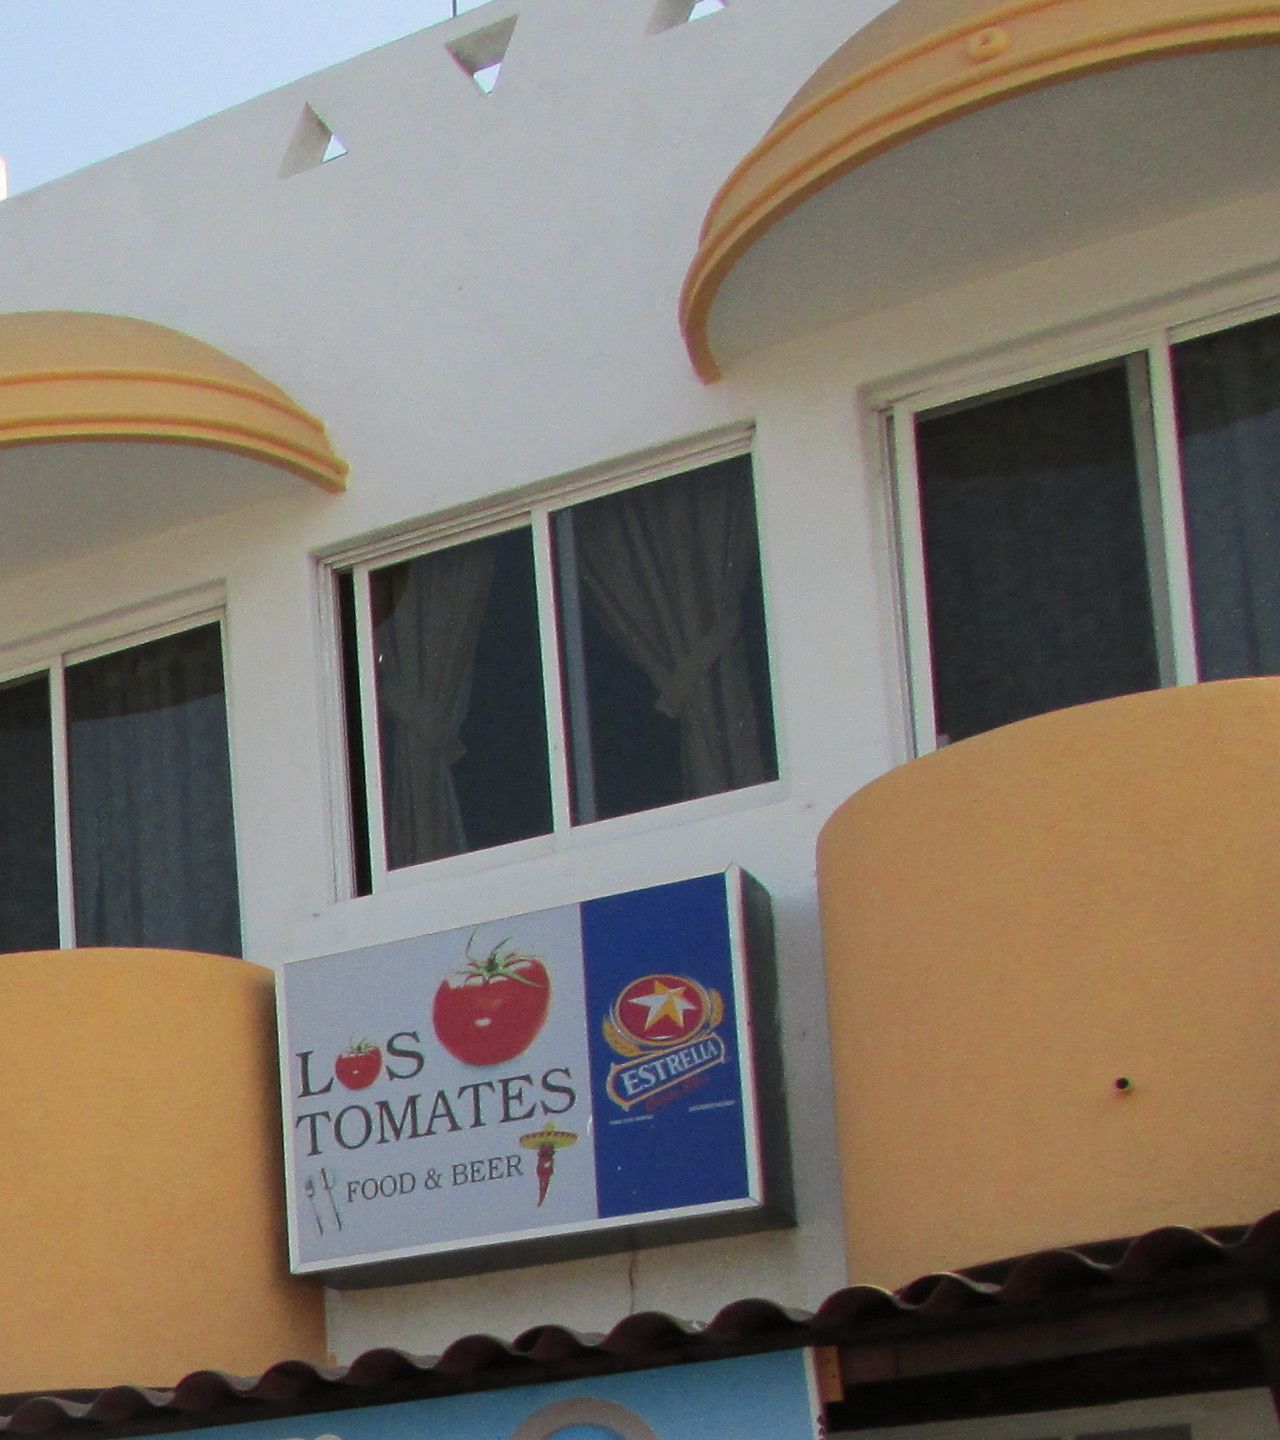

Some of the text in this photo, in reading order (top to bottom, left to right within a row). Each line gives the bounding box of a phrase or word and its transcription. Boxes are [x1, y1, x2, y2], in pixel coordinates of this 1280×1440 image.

[620, 1041, 719, 1096] ESTRELLA
[295, 1067, 577, 1158] TOMATES
[346, 1154, 525, 1203] FOOD & BEER
